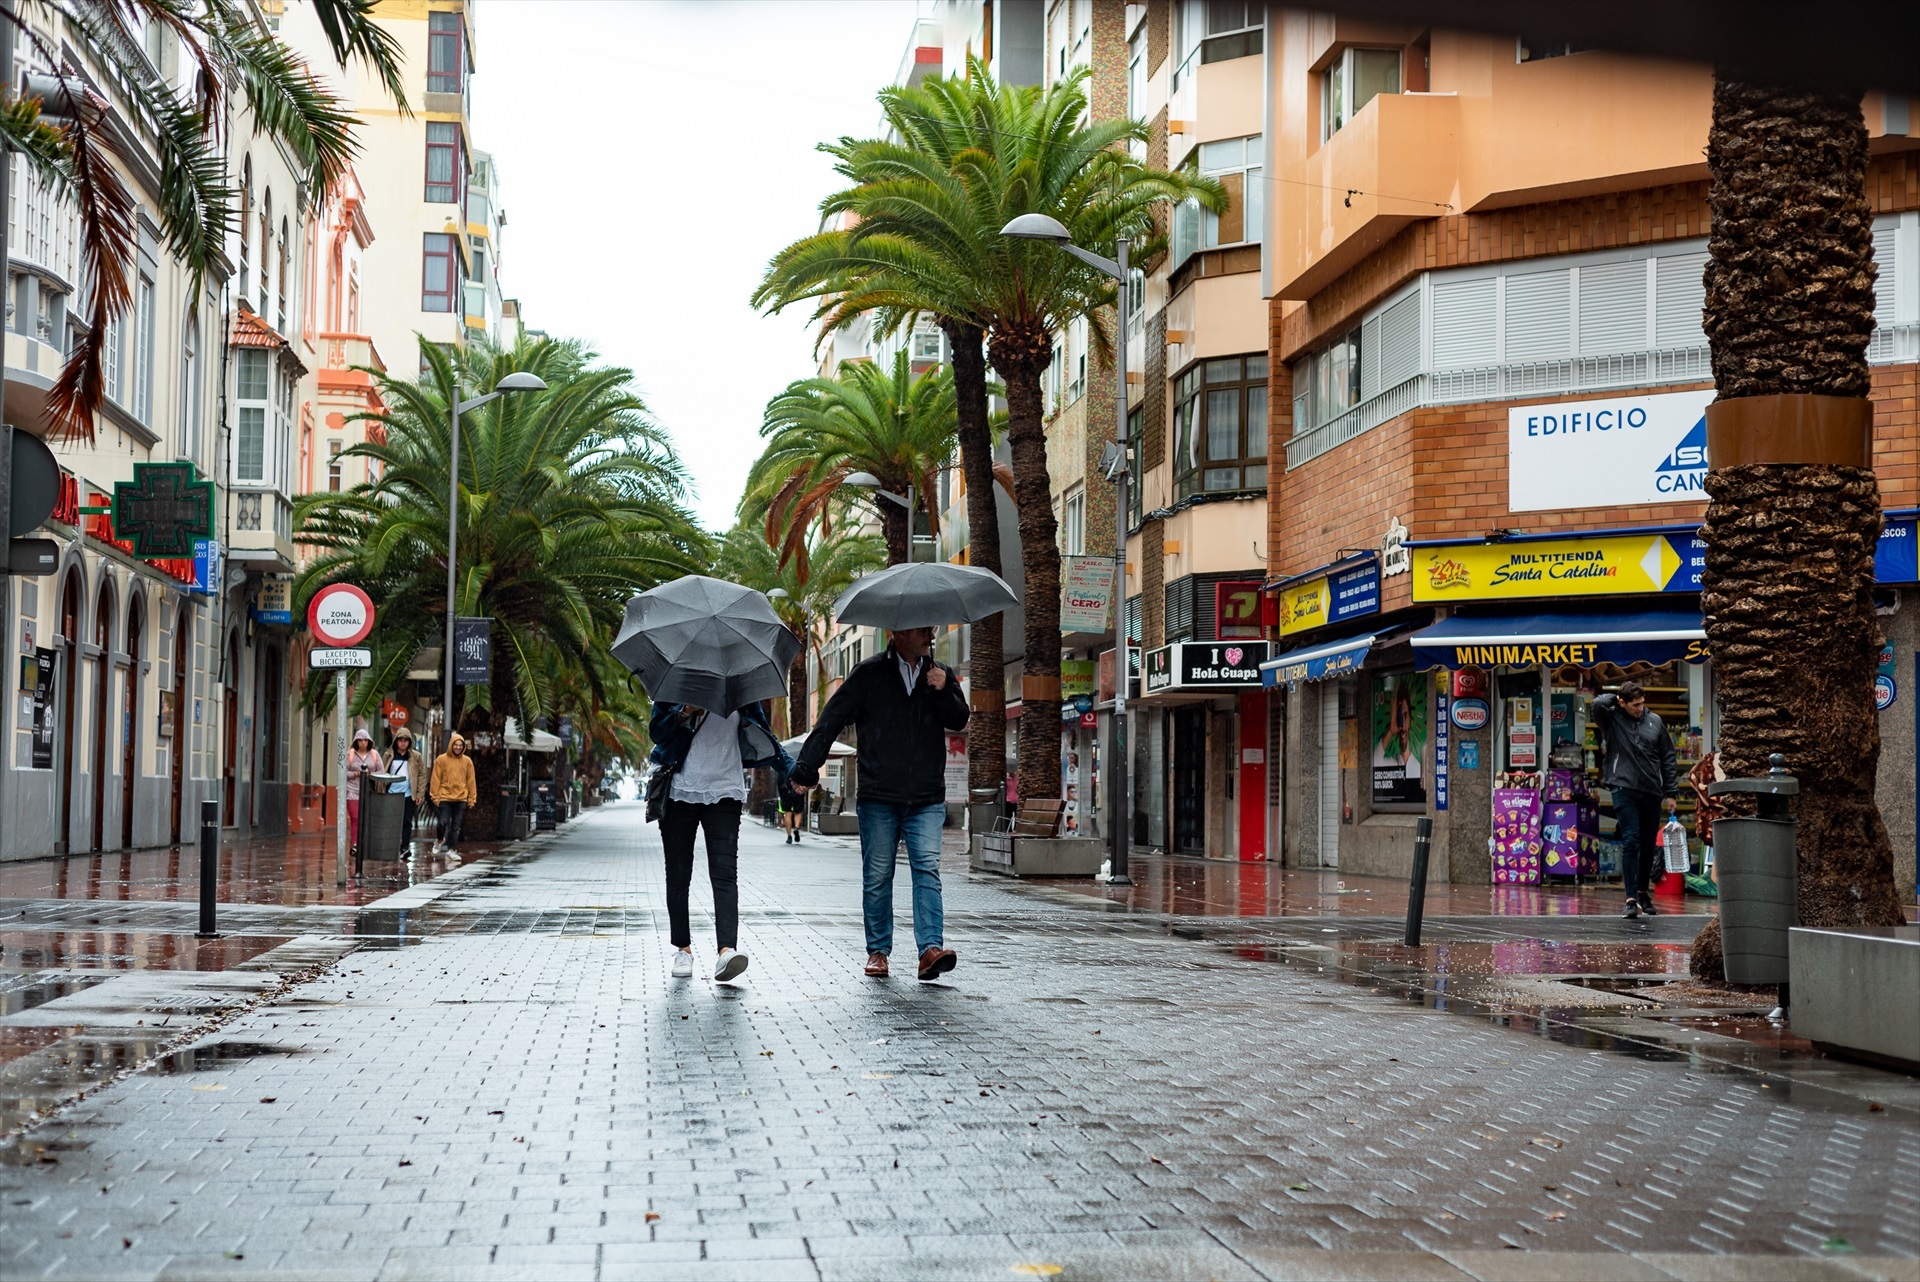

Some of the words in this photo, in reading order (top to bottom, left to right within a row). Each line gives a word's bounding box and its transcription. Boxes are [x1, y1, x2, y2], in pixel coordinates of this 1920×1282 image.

[1528, 407, 1647, 437] EDIFICIO
[1510, 550, 1604, 566] MULTITIENDA
[1490, 564, 1542, 586] Santa
[1549, 561, 1616, 580] Catalina
[263, 612, 285, 620] Blanco
[1211, 648, 1219, 665] I
[1456, 644, 1597, 664] MINIMARKET
[1191, 667, 1219, 679] Hola
[1220, 667, 1258, 680] Guapa
[1276, 662, 1308, 684] MULTITIENDA
[389, 709, 406, 719] ria
